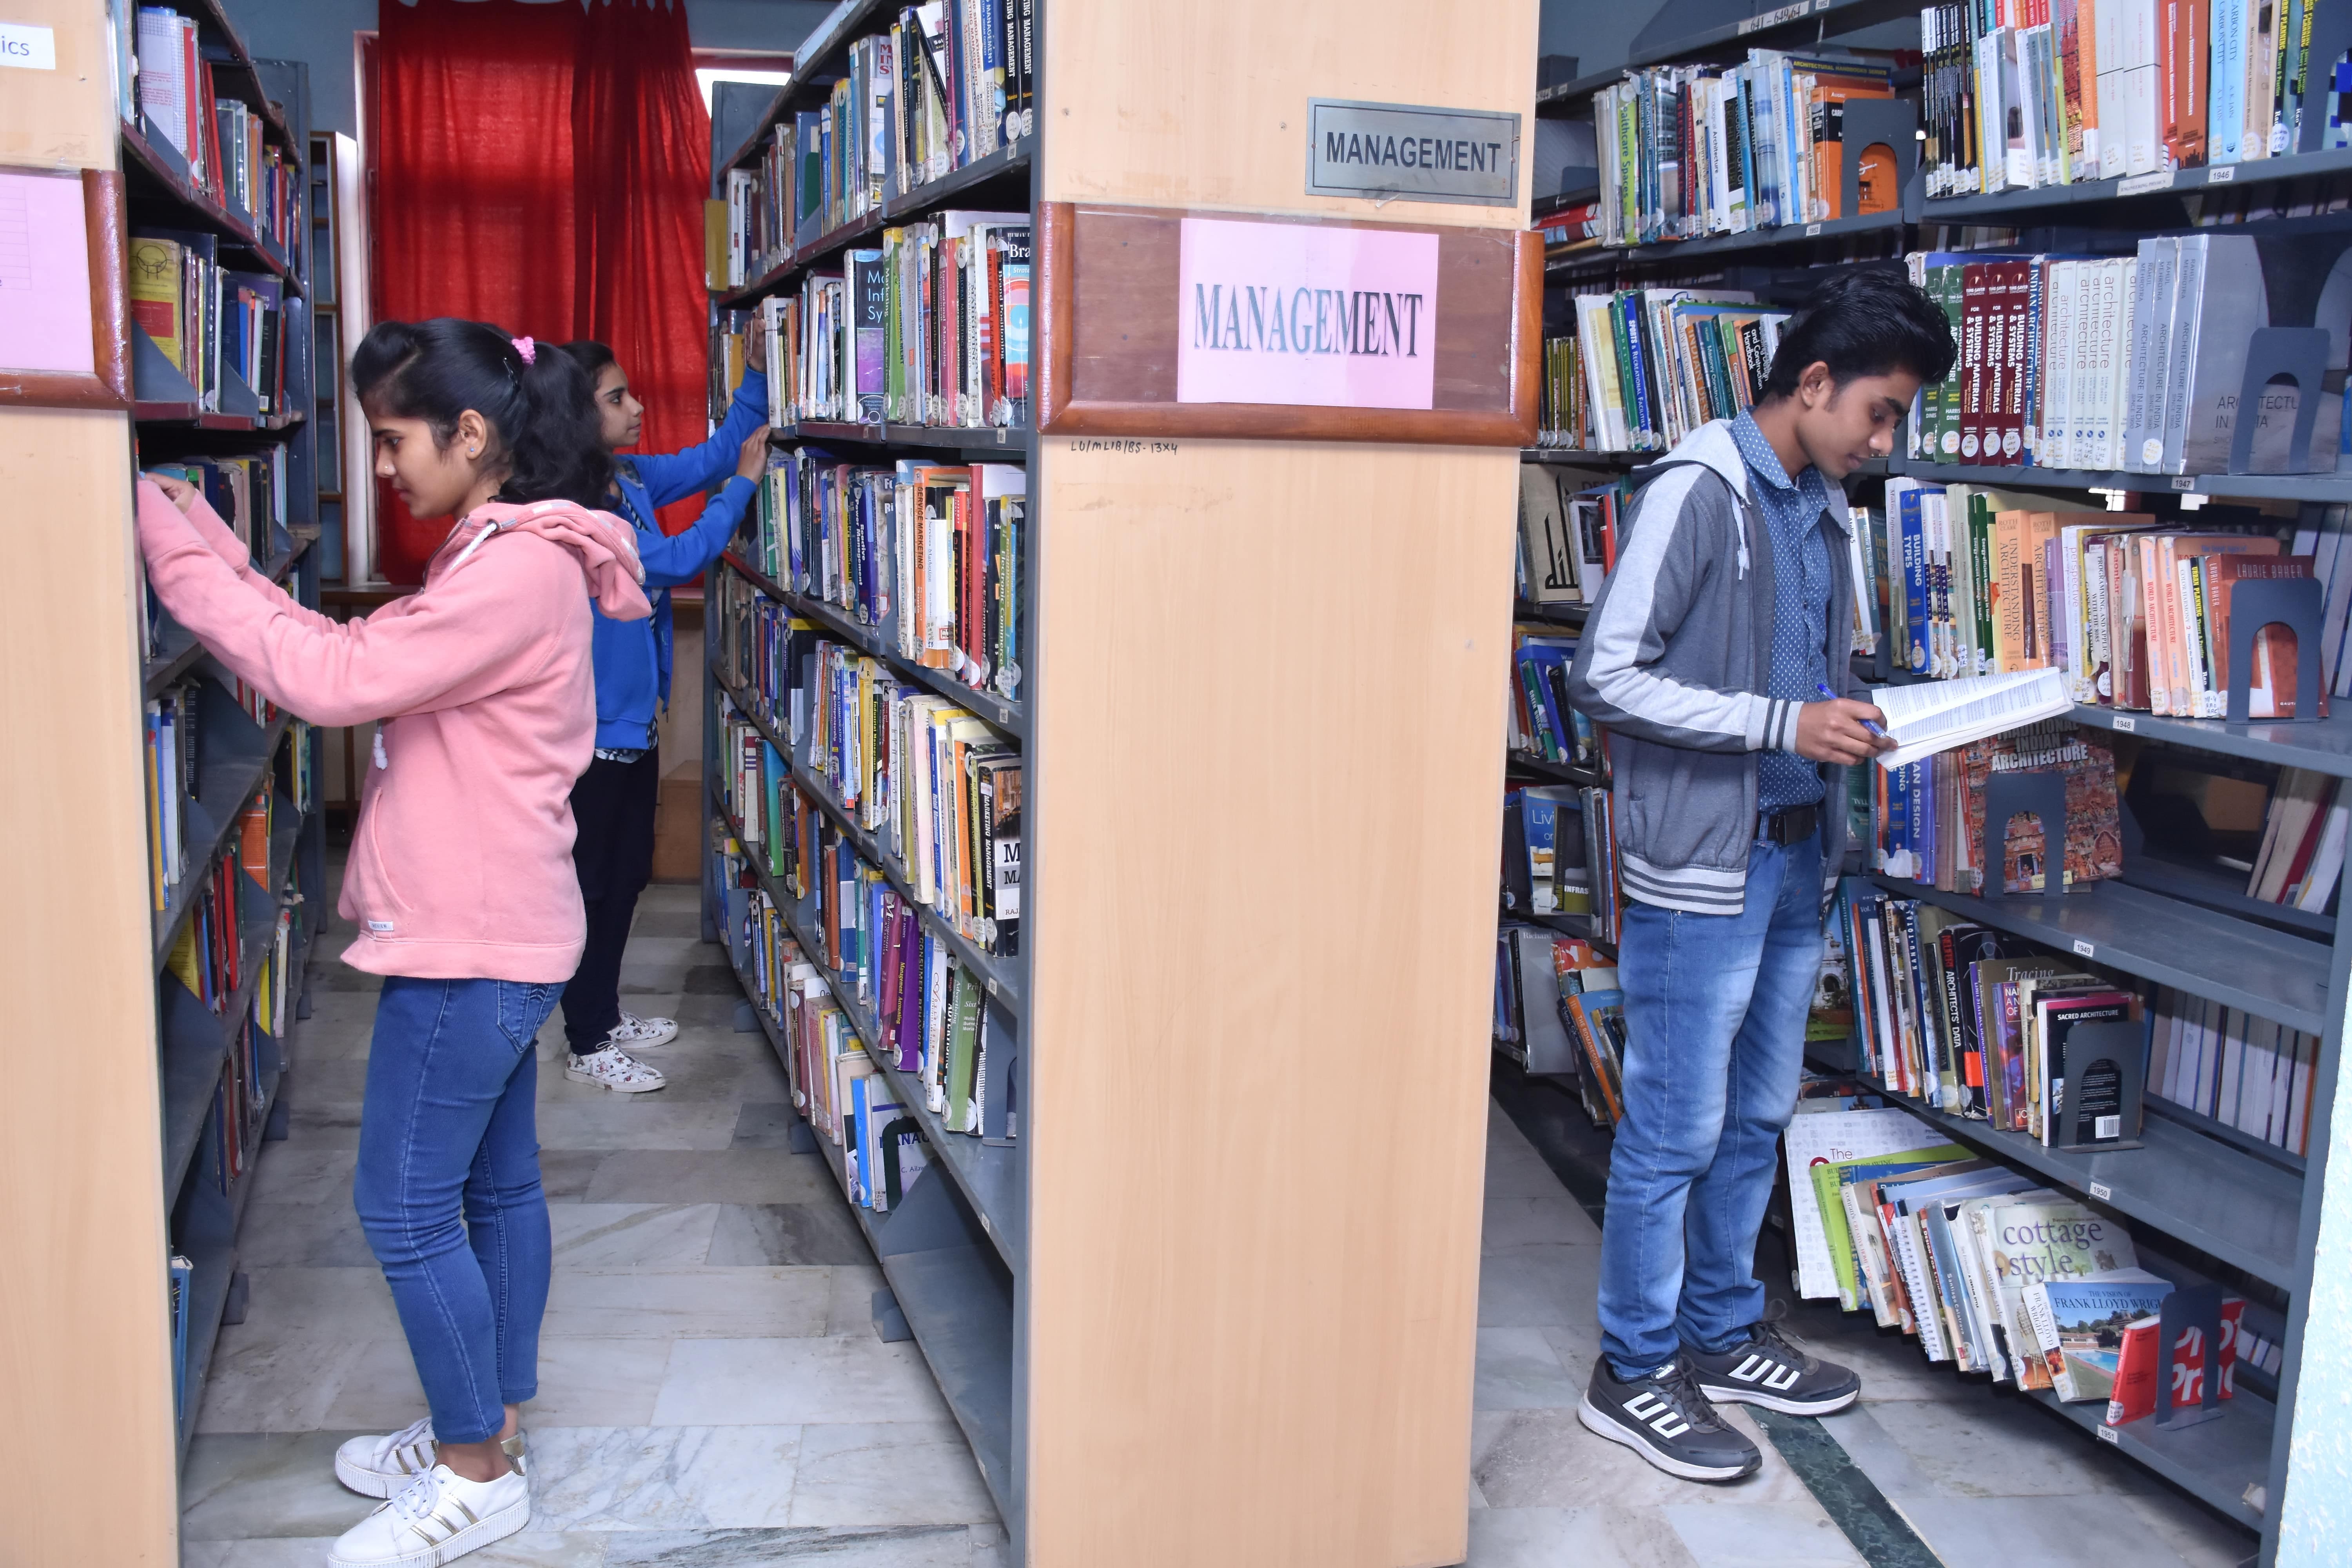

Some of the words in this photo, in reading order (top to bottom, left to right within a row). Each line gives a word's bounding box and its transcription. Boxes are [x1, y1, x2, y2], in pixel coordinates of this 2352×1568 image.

[1024, 18, 1032, 74] MANAGEMENT
[1750, 20, 1764, 31] 641
[2080, 3, 2090, 75] ARCHITECTURAL
[2279, 16, 2287, 50] PLANNING
[970, 27, 978, 87] MANAGEMENT
[1007, 23, 1015, 78] MANAGEMENT
[1793, 60, 1834, 71] ARCHITECTURAL
[1772, 84, 1783, 144] architecture
[2083, 77, 2092, 120] GRAPHICS
[1326, 131, 1501, 174] MANAGEMENT
[1621, 161, 1630, 198] Spaces
[2213, 171, 2230, 180] 1946
[2029, 269, 2038, 307] INDIAN
[1193, 283, 1423, 358] MANAGEMENT
[1973, 316, 1983, 361] BUILDING
[1989, 315, 1996, 323] &
[1994, 314, 2004, 360] BUILDING
[2016, 314, 2025, 360] BUILDING
[2058, 295, 2076, 370] architecture
[2100, 276, 2118, 368] architecture
[1687, 329, 1703, 381] INDIAN
[1744, 331, 1755, 370] Handbook
[1751, 345, 1762, 390] Construction
[1965, 327, 1973, 368] SYSTEMS
[1987, 326, 1995, 368] SYSTEMS
[2007, 325, 2015, 368] SYSTEMS
[2025, 310, 2037, 391] ARCHITECTURE
[2137, 323, 2148, 390] ARCHITECTURE
[2155, 323, 2167, 390] ARCHITECTURE
[2178, 321, 2189, 390] ARCHITECTURE
[1628, 320, 1637, 343] SPORTS
[1638, 396, 1646, 427] FACILITIES
[1681, 346, 1693, 395] DECORATING
[1706, 345, 1715, 373] Masonry
[1711, 374, 1721, 415] Construction
[1971, 363, 1980, 414] MATERIALS
[1993, 363, 2001, 413] MATERIALS
[2013, 363, 2022, 414] MATERIALS
[2137, 393, 2143, 403] IN
[2155, 393, 2161, 403] IN
[2176, 393, 2182, 403] IN
[2216, 415, 2229, 428] IN
[1904, 535, 1912, 568] TYPES
[1913, 534, 1922, 586] BUILDING
[2237, 564, 2267, 578] LAURIE
[2272, 565, 2303, 578] BAKER
[2000, 543, 2012, 639] ARCHITECTURE
[2009, 538, 2020, 641] UNDERSTANDING
[2034, 544, 2045, 641] ARCHITECTURE
[2069, 547, 2079, 607] perspective
[2148, 603, 2157, 642] ARCHITECTURE
[2167, 604, 2176, 644] ARCHITECTURE
[1992, 744, 2088, 771] ARCHITECTURE
[2015, 732, 2060, 752] INDIAN
[2076, 945, 2091, 954] 1949
[898, 962, 906, 995] Management
[2006, 966, 2054, 982] Tracing
[1577, 1015, 1586, 1027] THE
[2080, 1009, 2119, 1018] ARCHITECTURE
[1581, 1027, 1601, 1069] ROMANESQUE
[1952, 1027, 1961, 1048] DATA
[1830, 1148, 1853, 1160] The
[2092, 1187, 2108, 1196] 1950
[2004, 1220, 2104, 1250] cottage
[2010, 1245, 2074, 1283] style
[1947, 1273, 1956, 1303] Santiago
[1954, 1303, 1965, 1335] Calatrava
[2030, 1306, 2043, 1335] WRIGHT
[2033, 1292, 2046, 1319] FRANK
[2042, 1320, 2054, 1346] LLOYD
[2054, 1298, 2090, 1309] FRANK
[2092, 1298, 2128, 1309] LLOYD
[2100, 1430, 2116, 1439] 1951
